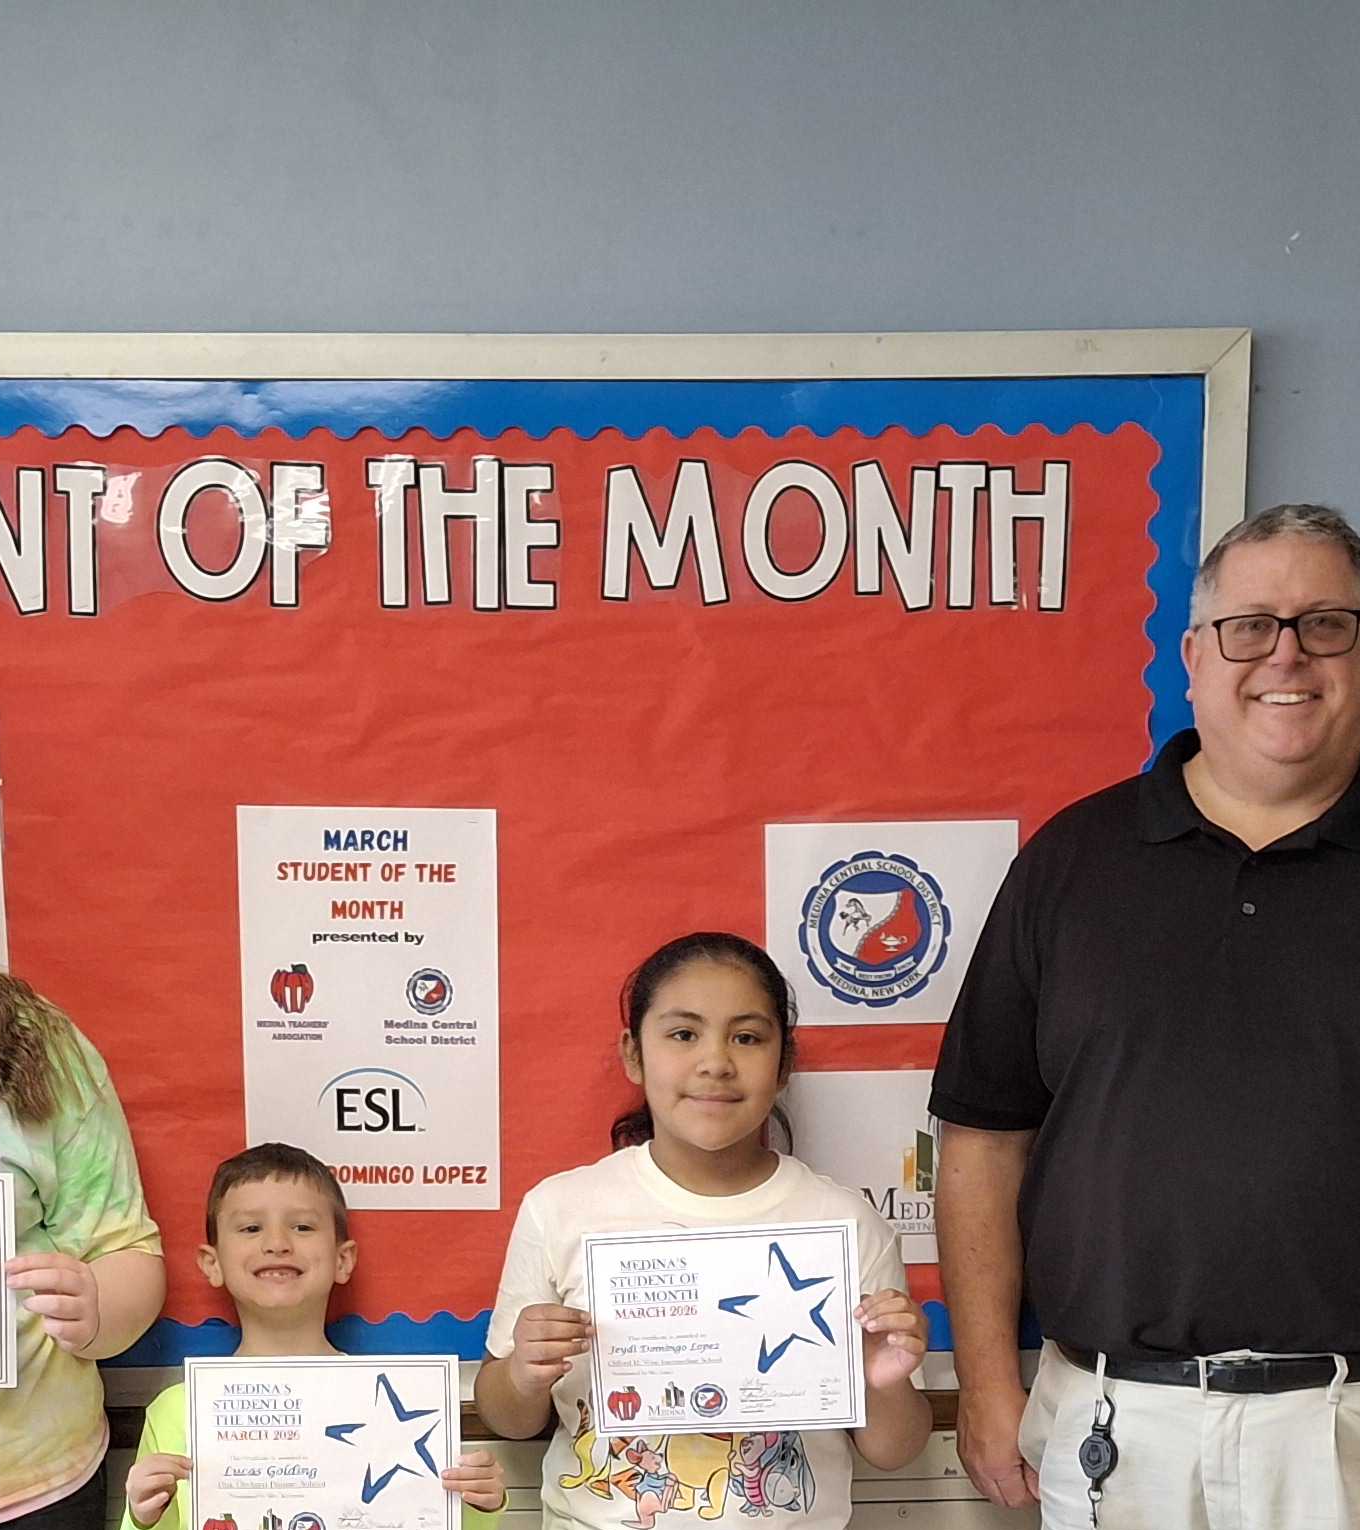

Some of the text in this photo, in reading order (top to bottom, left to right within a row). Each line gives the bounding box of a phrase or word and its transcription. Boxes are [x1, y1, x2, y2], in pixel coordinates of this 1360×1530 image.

[157, 456, 331, 608] OF
[366, 454, 560, 611] THE
[601, 459, 1070, 613] MONTH
[323, 828, 408, 852] MARCH
[276, 861, 457, 883] STUDENT OF THE
[808, 860, 943, 930] MEDINA CENTRAL SCHOOL DISTRICT
[331, 900, 404, 920] MONTH
[312, 931, 424, 946] presented by
[871, 986, 895, 998] NEW
[896, 970, 924, 993] YORK
[383, 1020, 478, 1030] Medina Central
[271, 1033, 323, 1041] ASSOCIATION
[384, 1035, 477, 1045] School District
[336, 1087, 417, 1132] ESL
[422, 1165, 488, 1184] LOPEZ
[620, 1256, 688, 1272] MEDINA'S
[609, 1272, 699, 1289] STUDENT OF
[611, 1288, 699, 1305] THE MONTH
[614, 1304, 698, 1321] MARCH 2026
[689, 1341, 721, 1353] Lopez
[223, 1383, 292, 1396] MEDINA'S
[213, 1398, 304, 1411] STUDENT OF
[215, 1414, 303, 1426] THE MONTH
[217, 1430, 301, 1441] MARCH 2026
[223, 1463, 318, 1479] Lucas Golding
